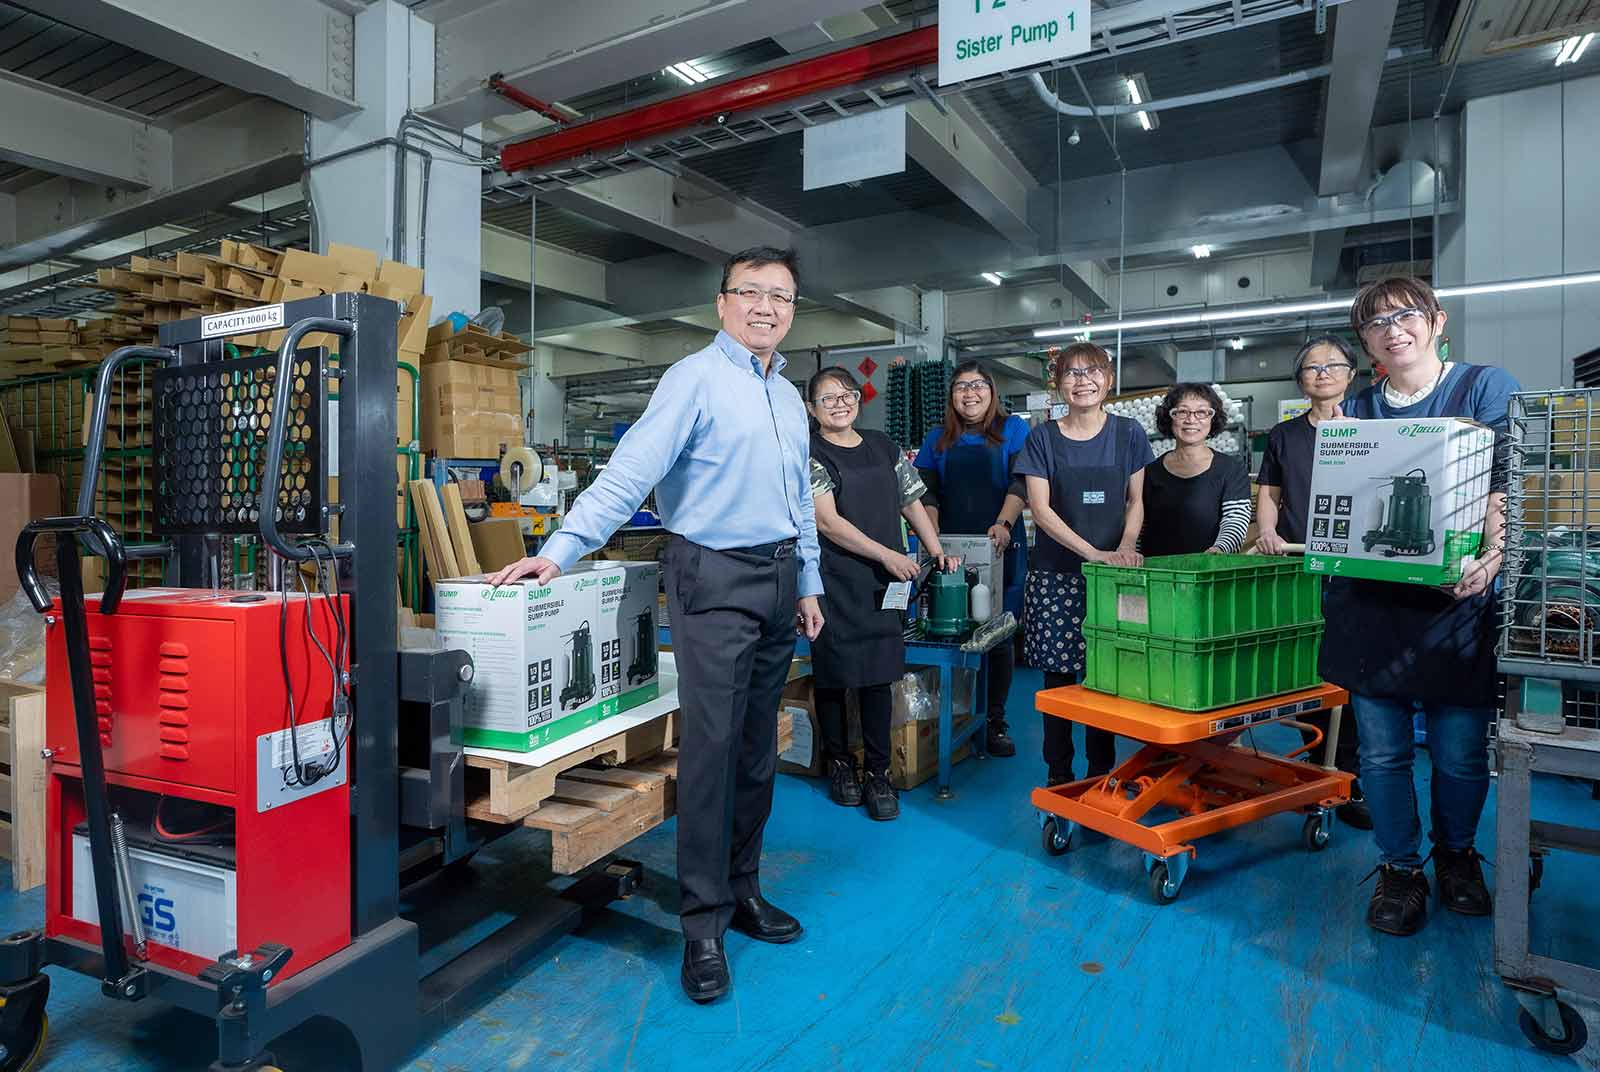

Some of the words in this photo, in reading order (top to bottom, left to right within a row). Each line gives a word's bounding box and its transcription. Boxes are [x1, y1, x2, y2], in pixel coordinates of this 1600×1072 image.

[956, 34, 1003, 60] Sister
[1011, 20, 1058, 46] Pump
[1067, 11, 1075, 32] 1
[207, 317, 246, 331] CAPACITY
[247, 313, 266, 325] 1000
[1321, 428, 1358, 438] SUMP
[1311, 541, 1331, 552] 100%
[601, 575, 621, 586] SUMP
[439, 590, 458, 598] SUMP
[528, 587, 552, 601] SUMP
[527, 599, 565, 614] SUBMERSIBLE
[527, 612, 544, 622] SUMP
[544, 608, 560, 618] PUMP
[137, 893, 176, 932] GS
